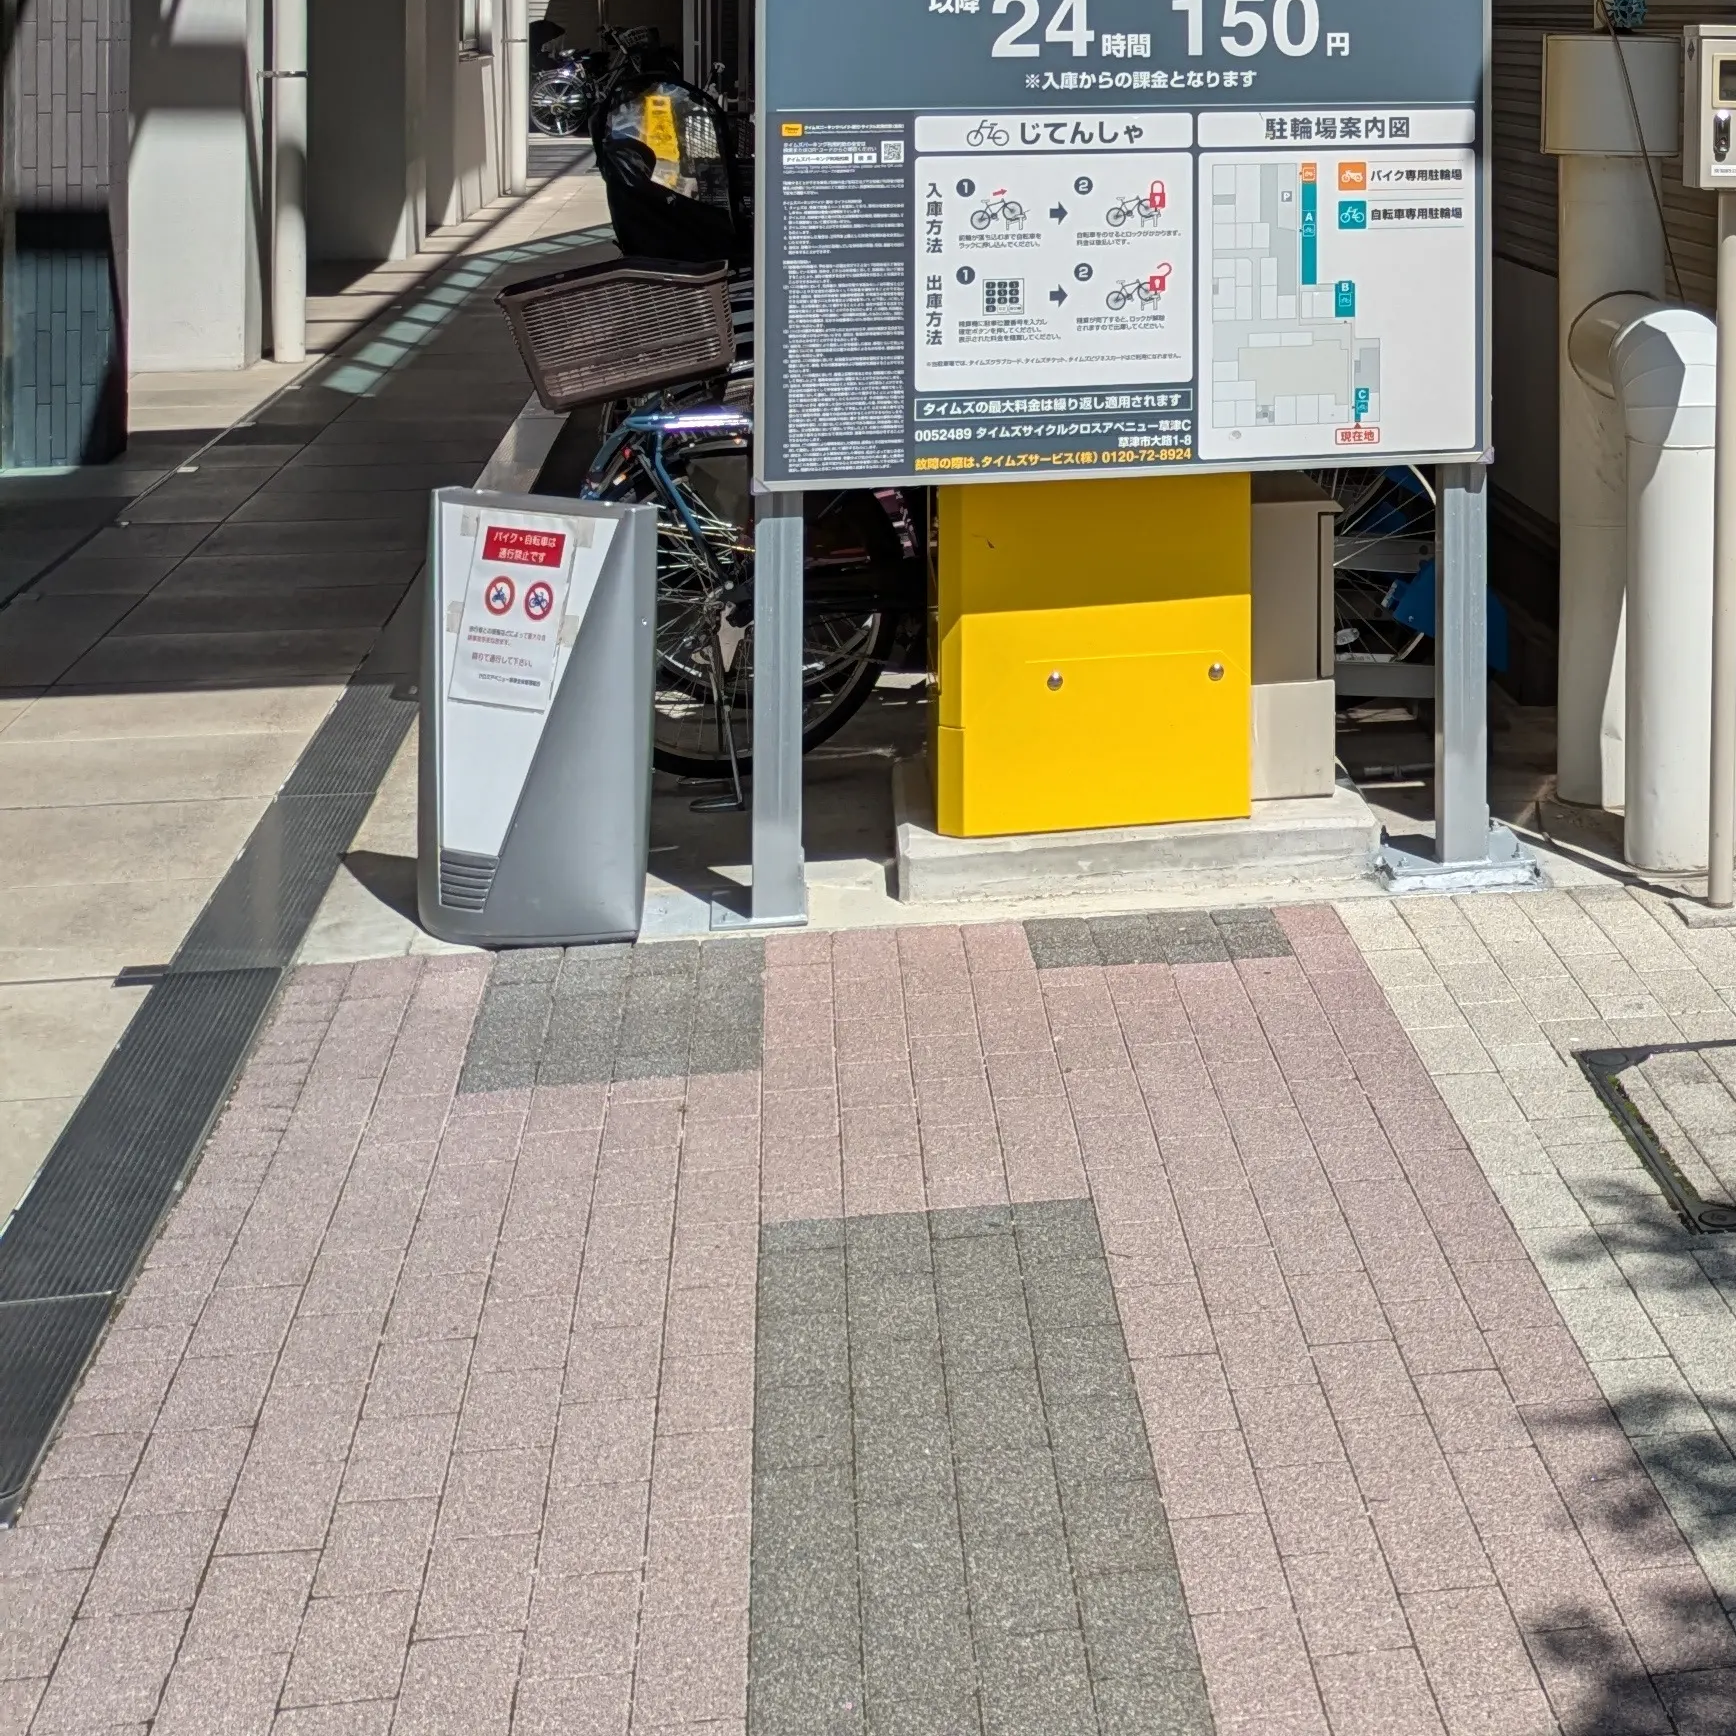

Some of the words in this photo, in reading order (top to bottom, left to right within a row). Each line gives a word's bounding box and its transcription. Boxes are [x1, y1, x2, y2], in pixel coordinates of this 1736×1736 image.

[1024, 69, 1257, 91] ※入庫からの課金となります
[1020, 120, 1145, 145] じてんしゃ
[1265, 115, 1411, 142] 駐輪場案内図
[1370, 168, 1463, 182] バイク専用駐輪場
[926, 182, 943, 254] 入庫方法
[1305, 212, 1314, 221] A
[1370, 207, 1463, 221] 自転車専用駐輪場
[1341, 283, 1350, 291] B
[926, 274, 943, 345] 出庫方法
[1358, 389, 1366, 399] C
[923, 393, 1182, 416] タイムズの最大料金は繰り返し適用されます
[915, 428, 972, 442] 0052489
[1118, 435, 1192, 448] 草津市大路1-8
[1340, 430, 1375, 442] 現在地
[1101, 449, 1192, 463] 0120-72-8924
[493, 531, 557, 548] バイク・自転車は
[498, 547, 547, 563] 通行禁止です
